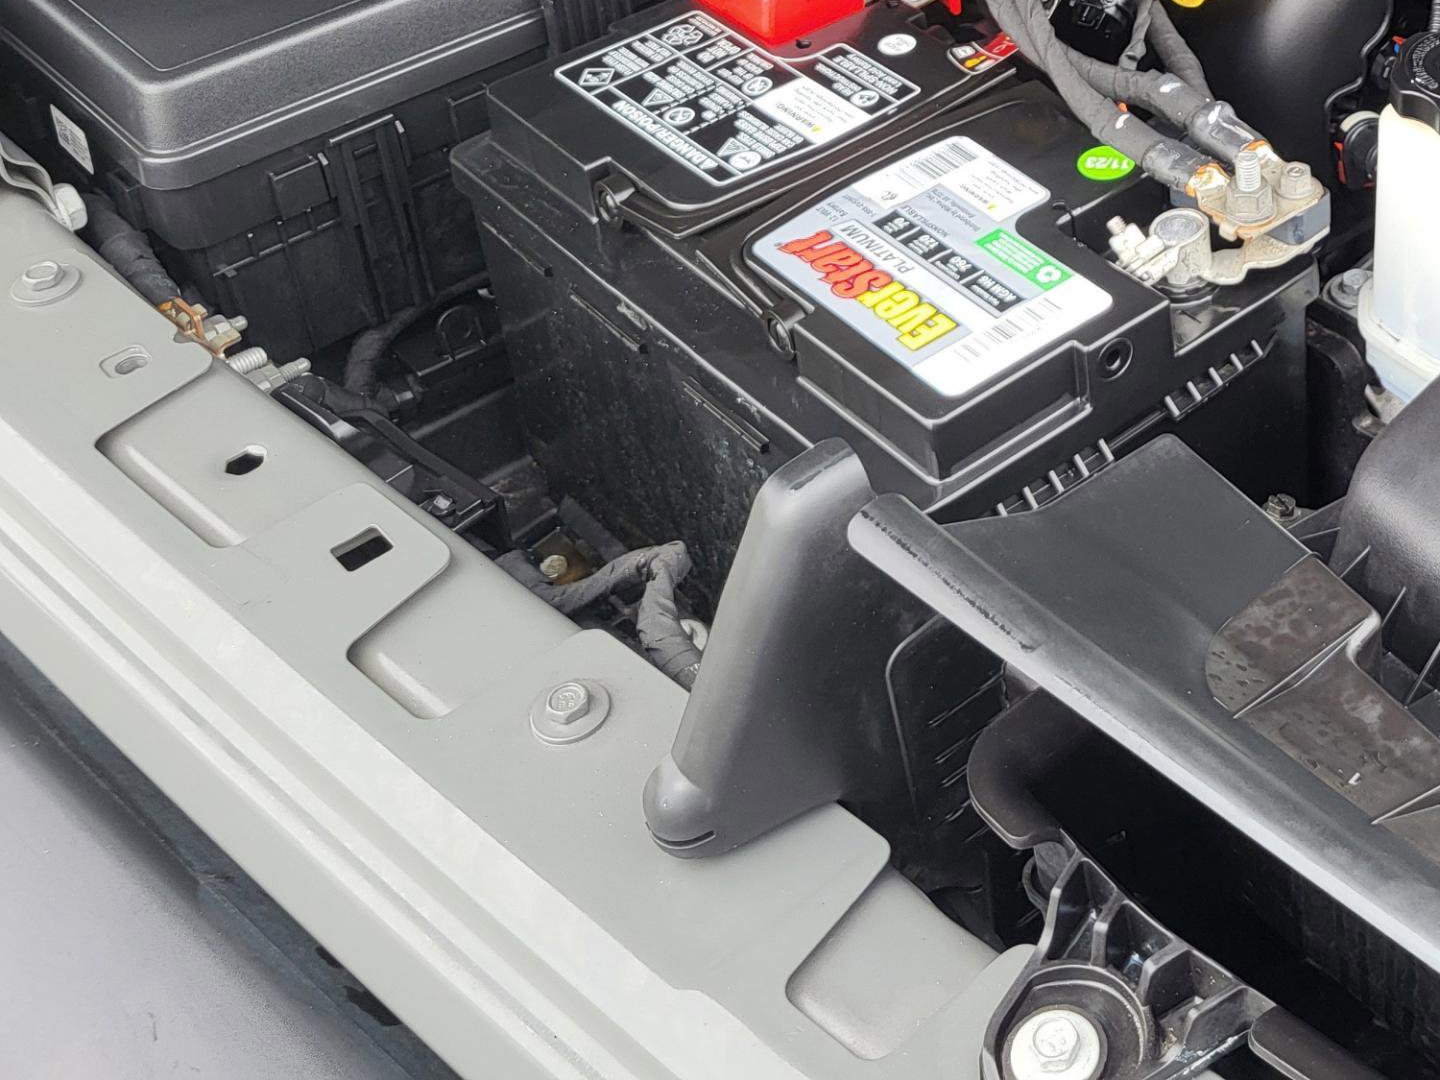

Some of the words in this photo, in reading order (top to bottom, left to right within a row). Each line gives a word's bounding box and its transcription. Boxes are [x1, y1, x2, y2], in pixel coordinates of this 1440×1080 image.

[612, 99, 709, 163] DANGER/POISON
[1085, 156, 1129, 171] 11/23
[839, 223, 915, 274] PLATINUM
[779, 229, 960, 352] EverStart
[990, 284, 1016, 303] AGM
